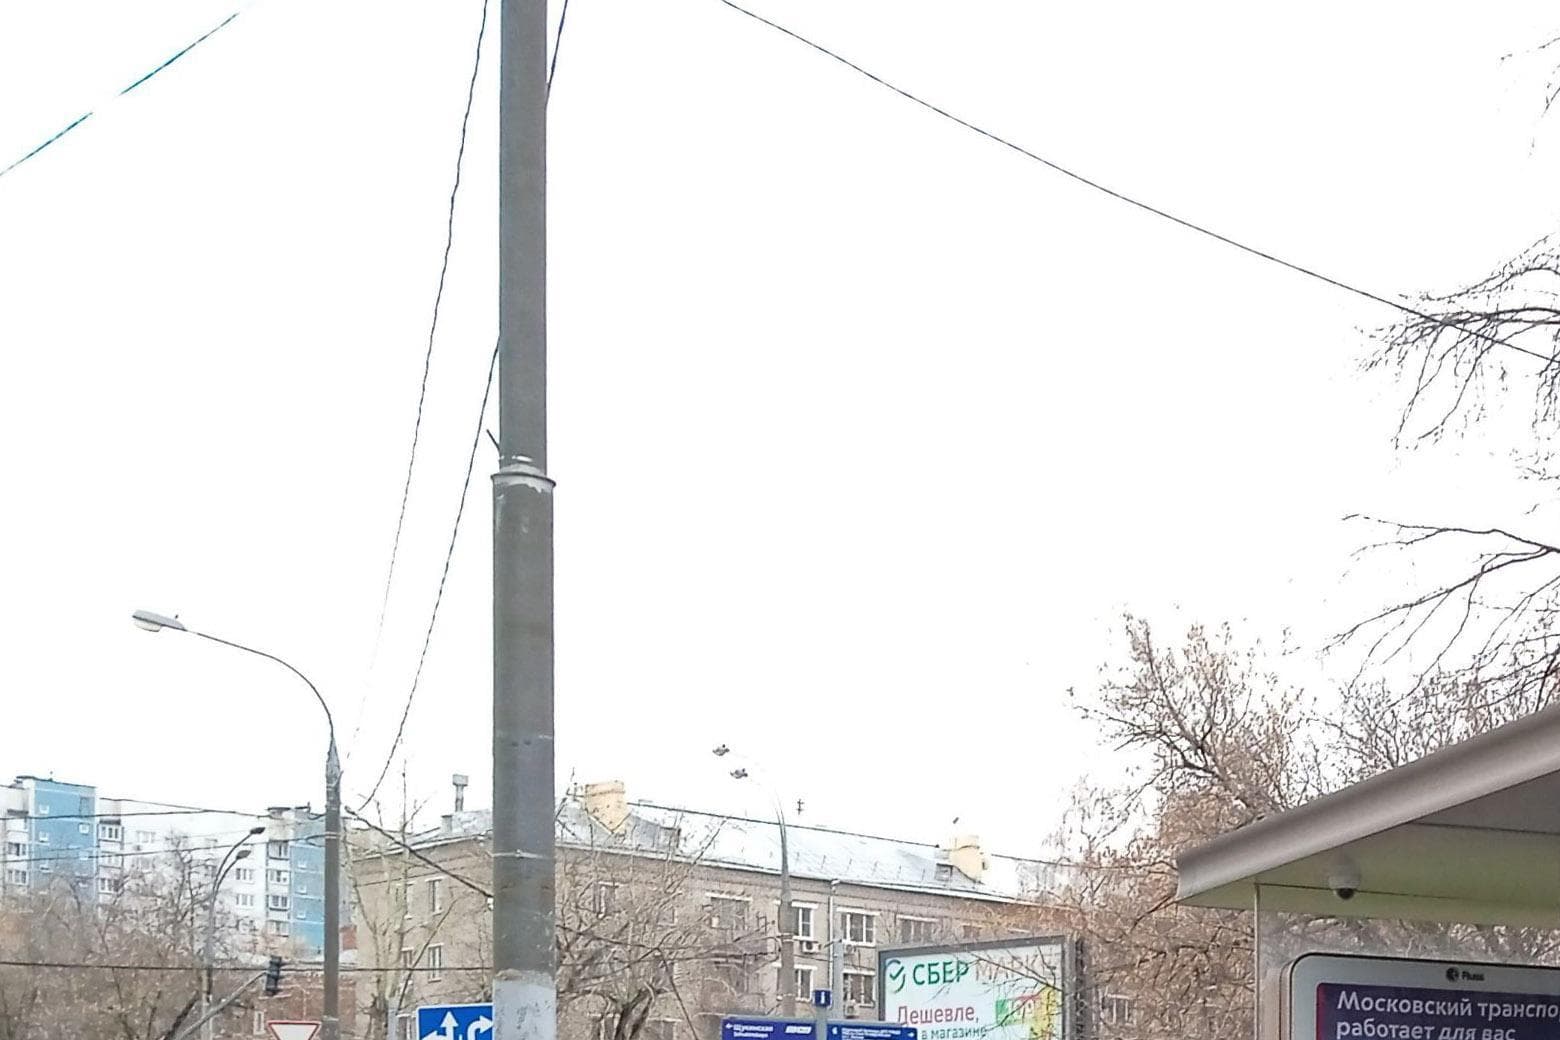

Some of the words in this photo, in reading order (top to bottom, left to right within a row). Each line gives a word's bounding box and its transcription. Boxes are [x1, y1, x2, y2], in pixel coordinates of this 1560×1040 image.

[912, 959, 970, 986] СБЕР
[897, 1005, 979, 1027] Дешевле,
[1336, 990, 1474, 1019] Московский
[1336, 1018, 1435, 1040] работает
